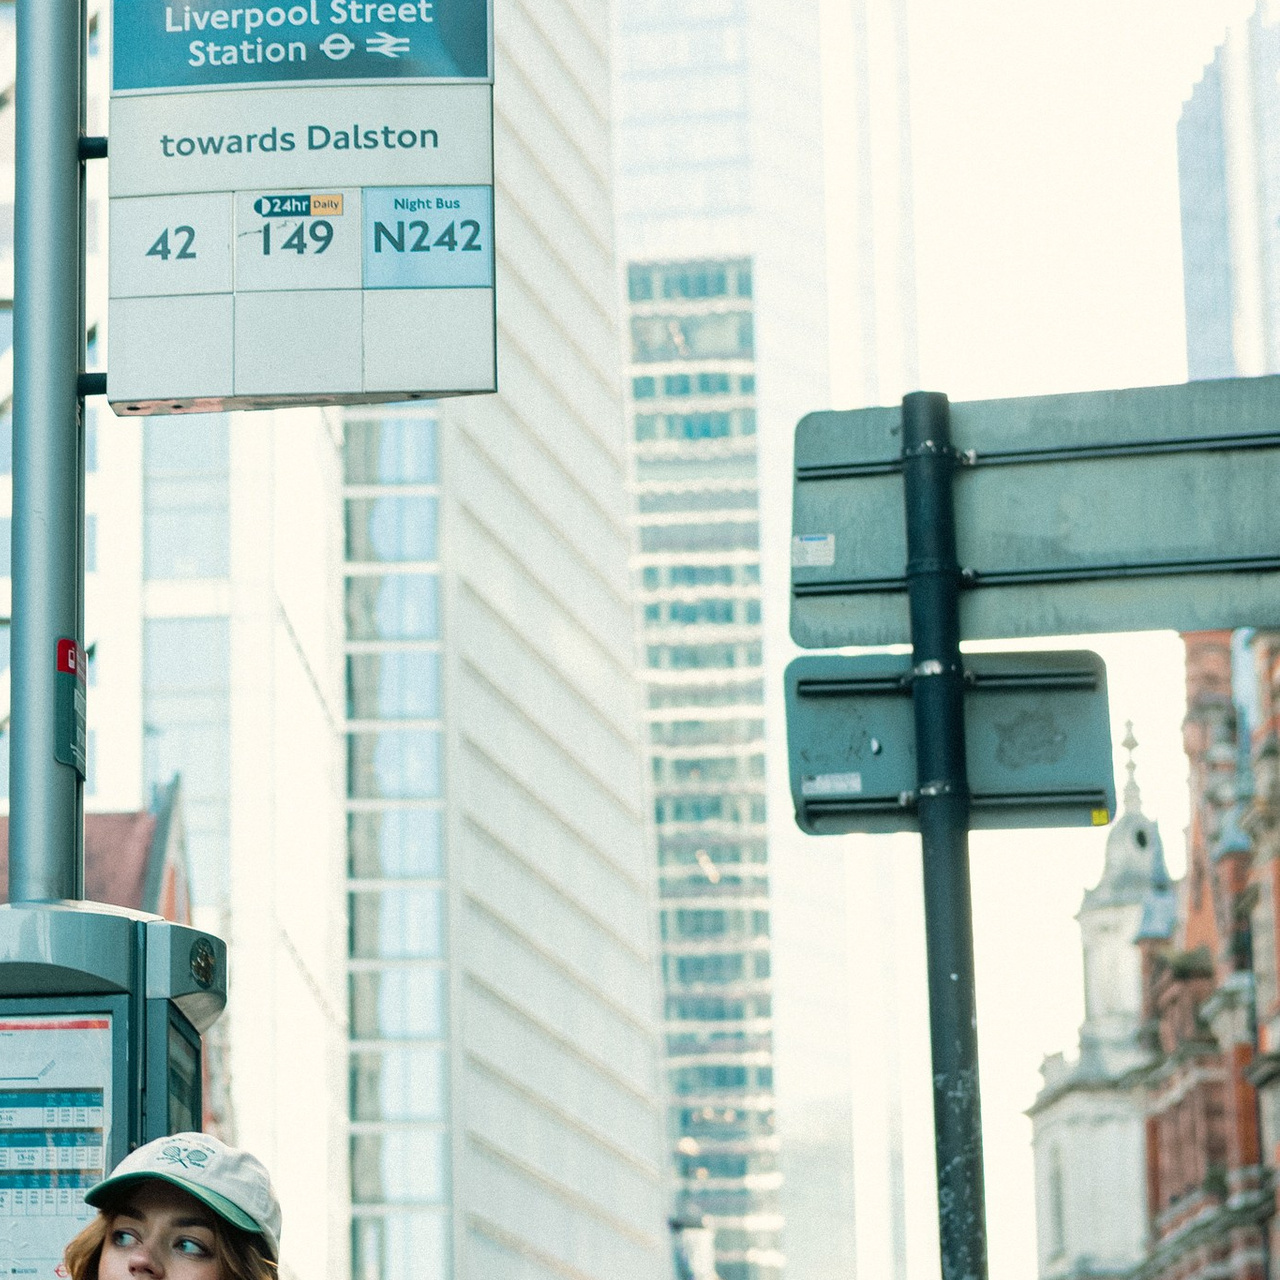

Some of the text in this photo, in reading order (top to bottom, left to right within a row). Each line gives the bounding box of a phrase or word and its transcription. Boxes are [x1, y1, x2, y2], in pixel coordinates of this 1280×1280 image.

[165, 0, 320, 34] Liverpool
[188, 37, 307, 67] Station
[160, 123, 439, 158] towards Dalston
[271, 196, 340, 213] 24hr Daily
[394, 197, 461, 211] Night Bus
[145, 225, 197, 261] 42
[260, 219, 335, 256] 149
[373, 219, 483, 254] N242
